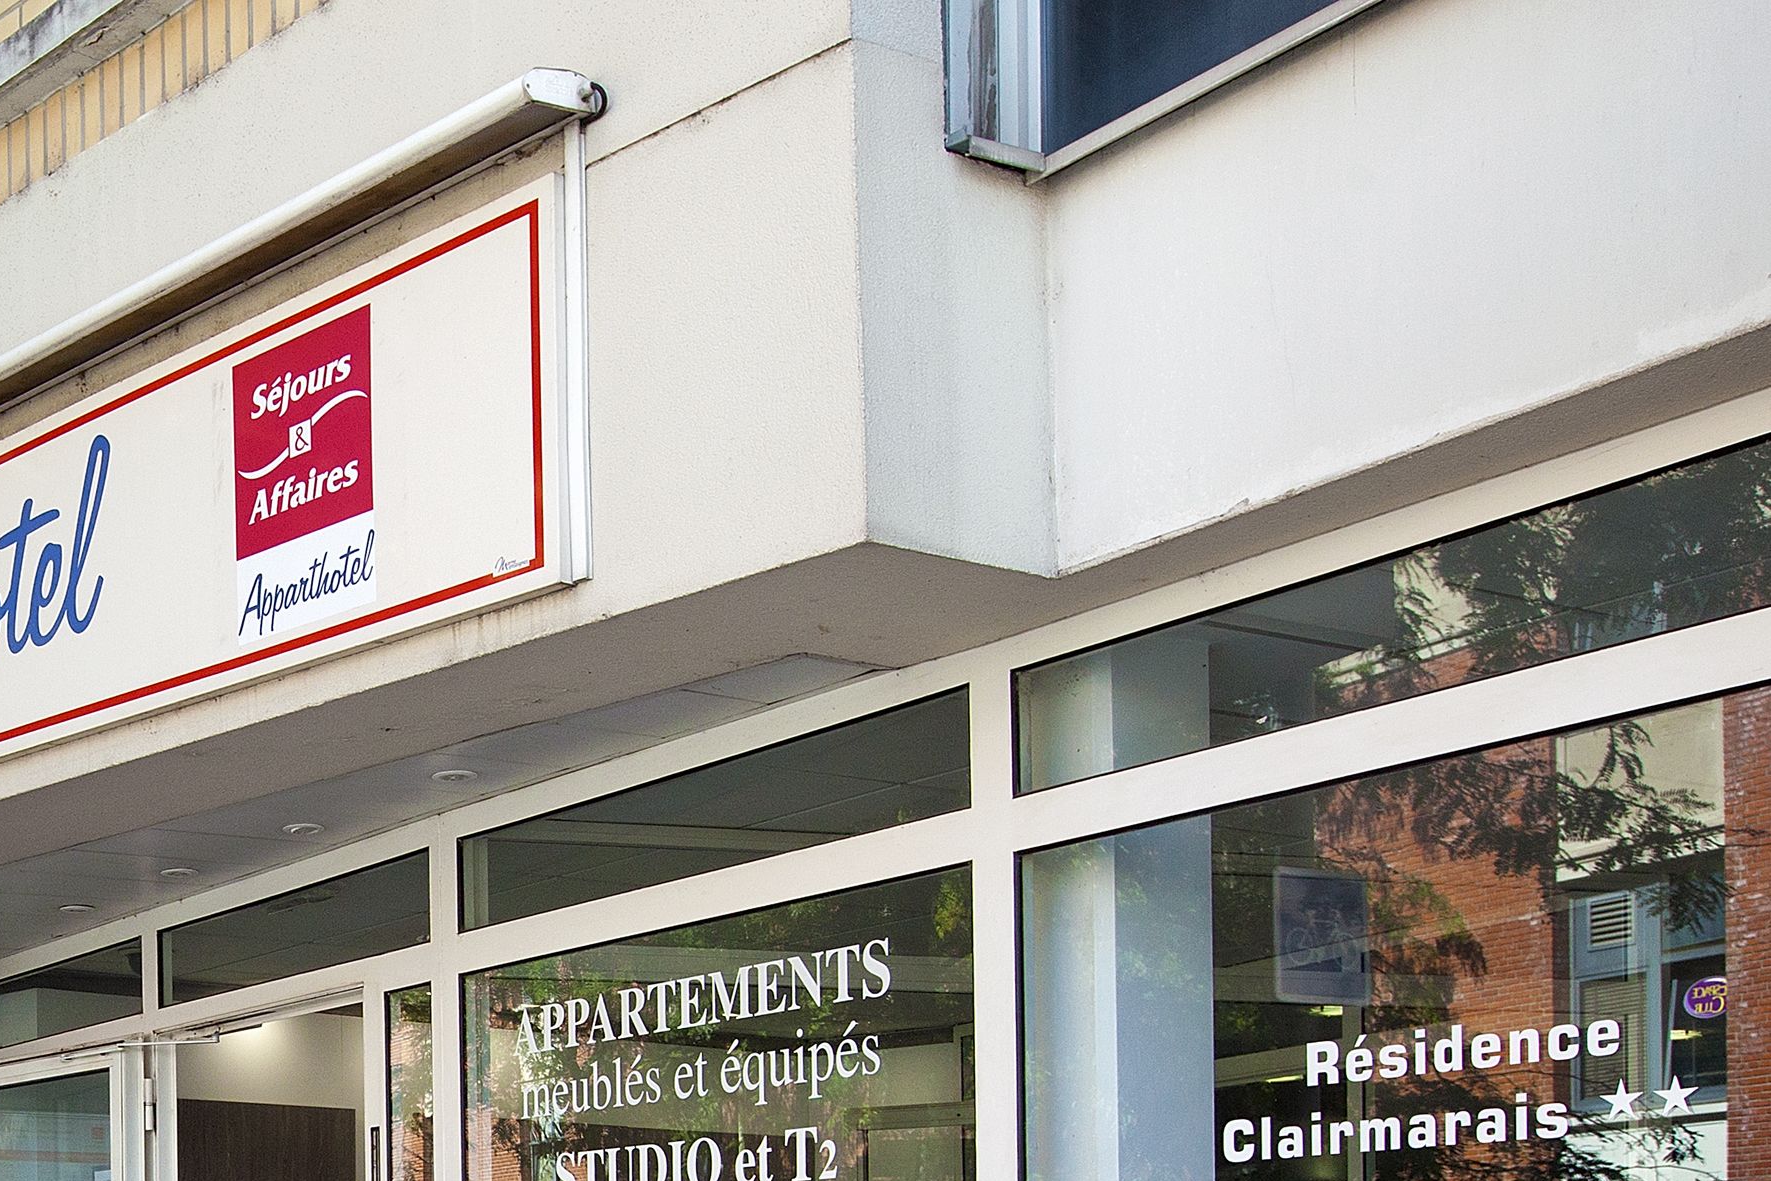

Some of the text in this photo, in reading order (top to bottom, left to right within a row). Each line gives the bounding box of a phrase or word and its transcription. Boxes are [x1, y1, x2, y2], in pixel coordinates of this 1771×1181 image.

[250, 353, 352, 419] Séjours
[294, 426, 309, 452] &
[248, 459, 359, 526] Affaires
[238, 529, 375, 637] Apparthotel
[513, 937, 891, 1057] APPARTEMENTS
[520, 1020, 881, 1119] meublés et équipés
[1305, 1018, 1620, 1087] Résidence
[1222, 1093, 1570, 1163] Clairmarais
